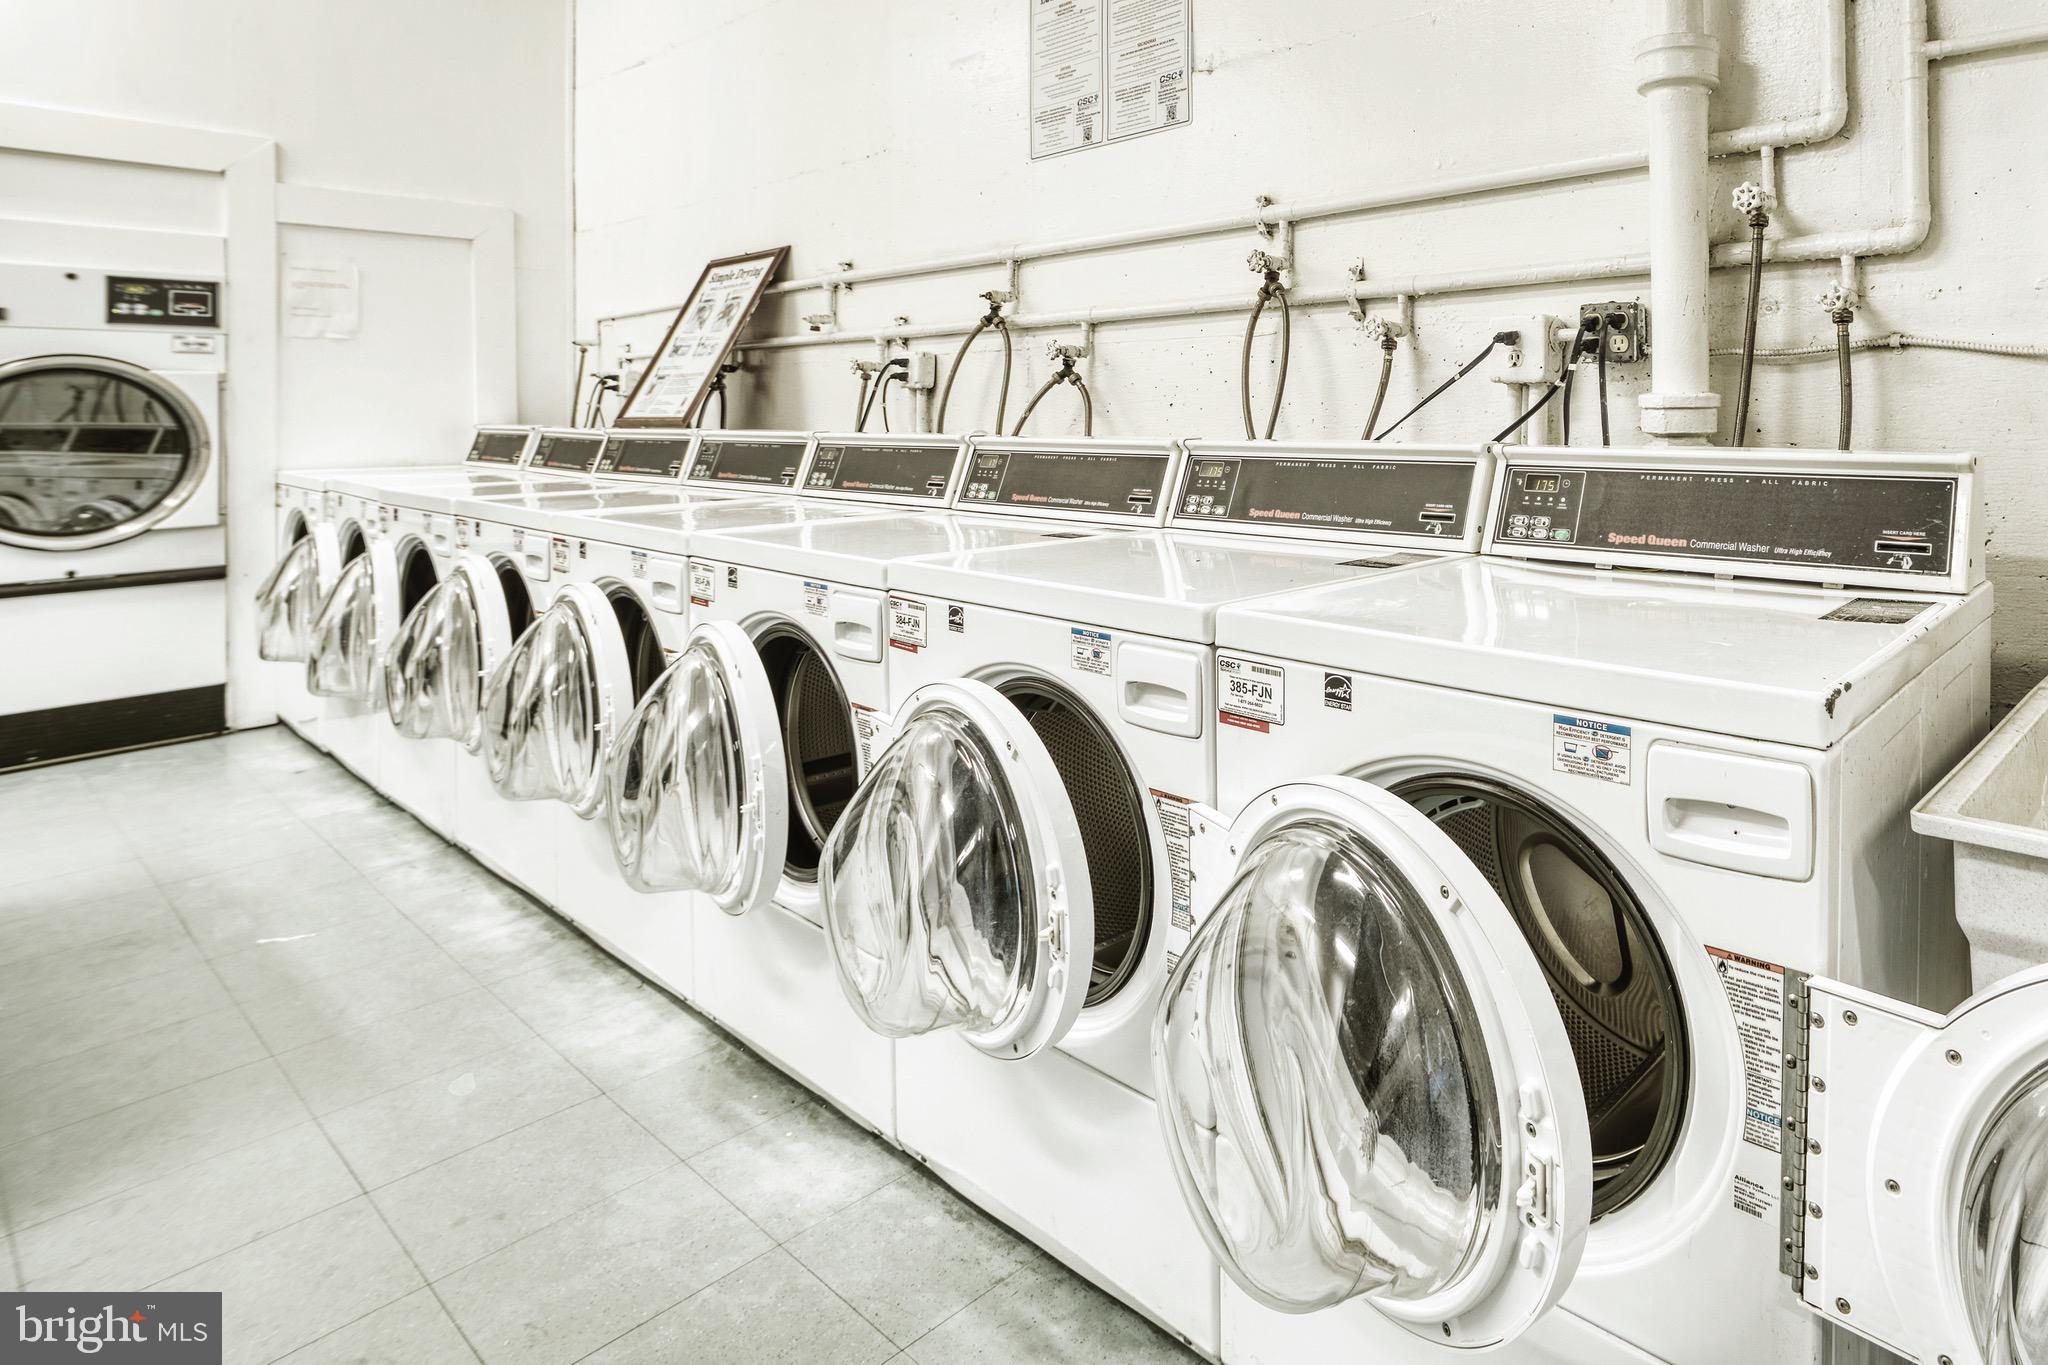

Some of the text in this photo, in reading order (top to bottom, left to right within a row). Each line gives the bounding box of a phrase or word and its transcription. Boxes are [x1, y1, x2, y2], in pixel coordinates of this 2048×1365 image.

[1535, 480, 1555, 491] 175
[1249, 508, 1274, 519] Speed
[1275, 510, 1300, 520] Queen
[1302, 512, 1332, 523] Commercial
[1333, 514, 1353, 524] Washer
[1608, 532, 1832, 558] Speed Queen Commercial Washer Ultra High Efficiency
[1220, 660, 1236, 669] CSC
[1577, 719, 1608, 731] NOTICE
[1556, 731, 1583, 740] RECOMMENDED
[1601, 738, 1628, 748] PERFORMANCE
[1600, 733, 1622, 741] DETERGENT
[1564, 763, 1586, 771] DETERGENT
[1734, 954, 1771, 970] WARNING
[1743, 979, 1764, 989] flammable
[1742, 1006, 1760, 1015] vegetable
[1766, 1013, 1781, 1021] cooking
[1744, 1038, 1758, 1046] Clothes
[1766, 1045, 1781, 1054] moving
[1764, 1060, 1781, 1069] children
[1752, 1094, 1767, 1102] minutes
[1747, 1108, 1782, 1126] NOTICE
[1747, 1127, 1761, 1135] indicator
[1734, 1175, 1764, 1190] Alliance
[1749, 1200, 1767, 1211] NUMBER
